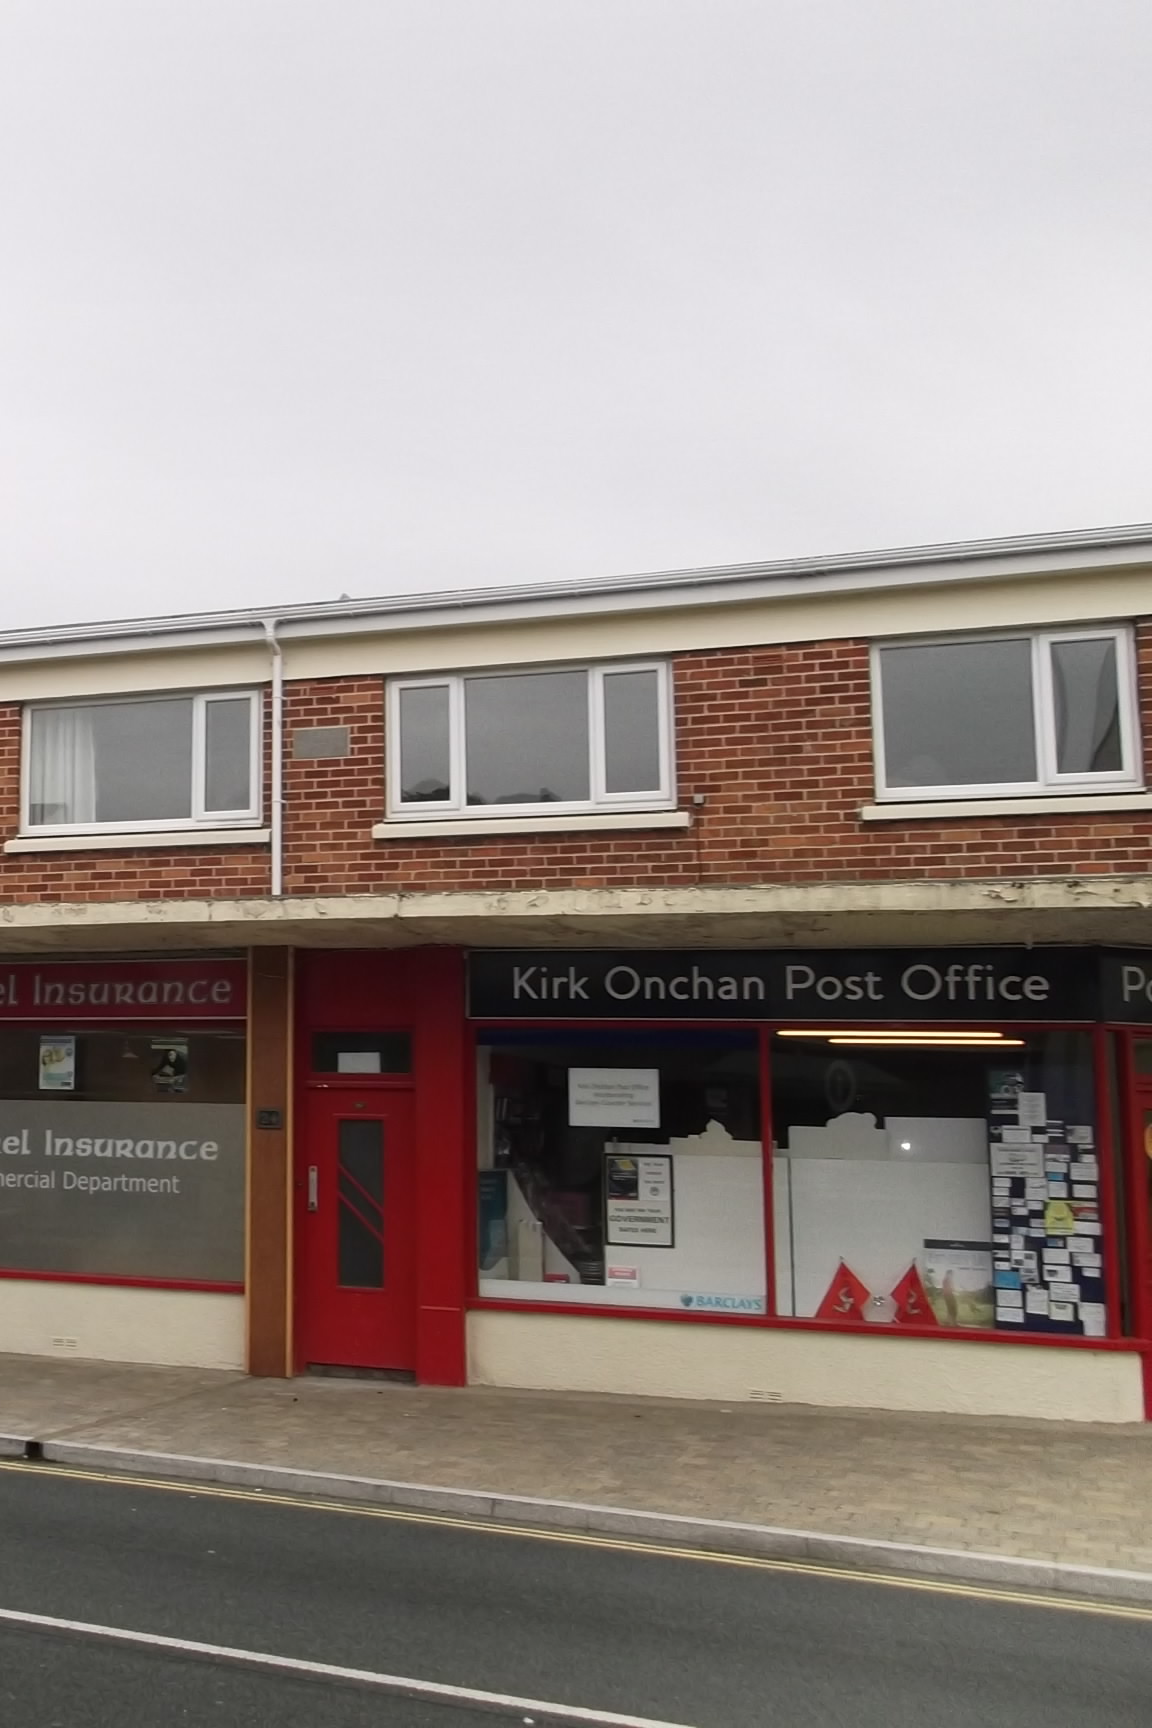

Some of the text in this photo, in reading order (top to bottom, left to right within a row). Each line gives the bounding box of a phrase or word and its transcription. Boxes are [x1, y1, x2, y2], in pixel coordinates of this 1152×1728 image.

[34, 974, 231, 1005] Insurance
[513, 964, 1050, 1000] Kirk Onchan Post Office
[45, 1129, 219, 1160] Insurance
[63, 1171, 181, 1195] Department
[696, 1295, 762, 1311] BARCLAYS
